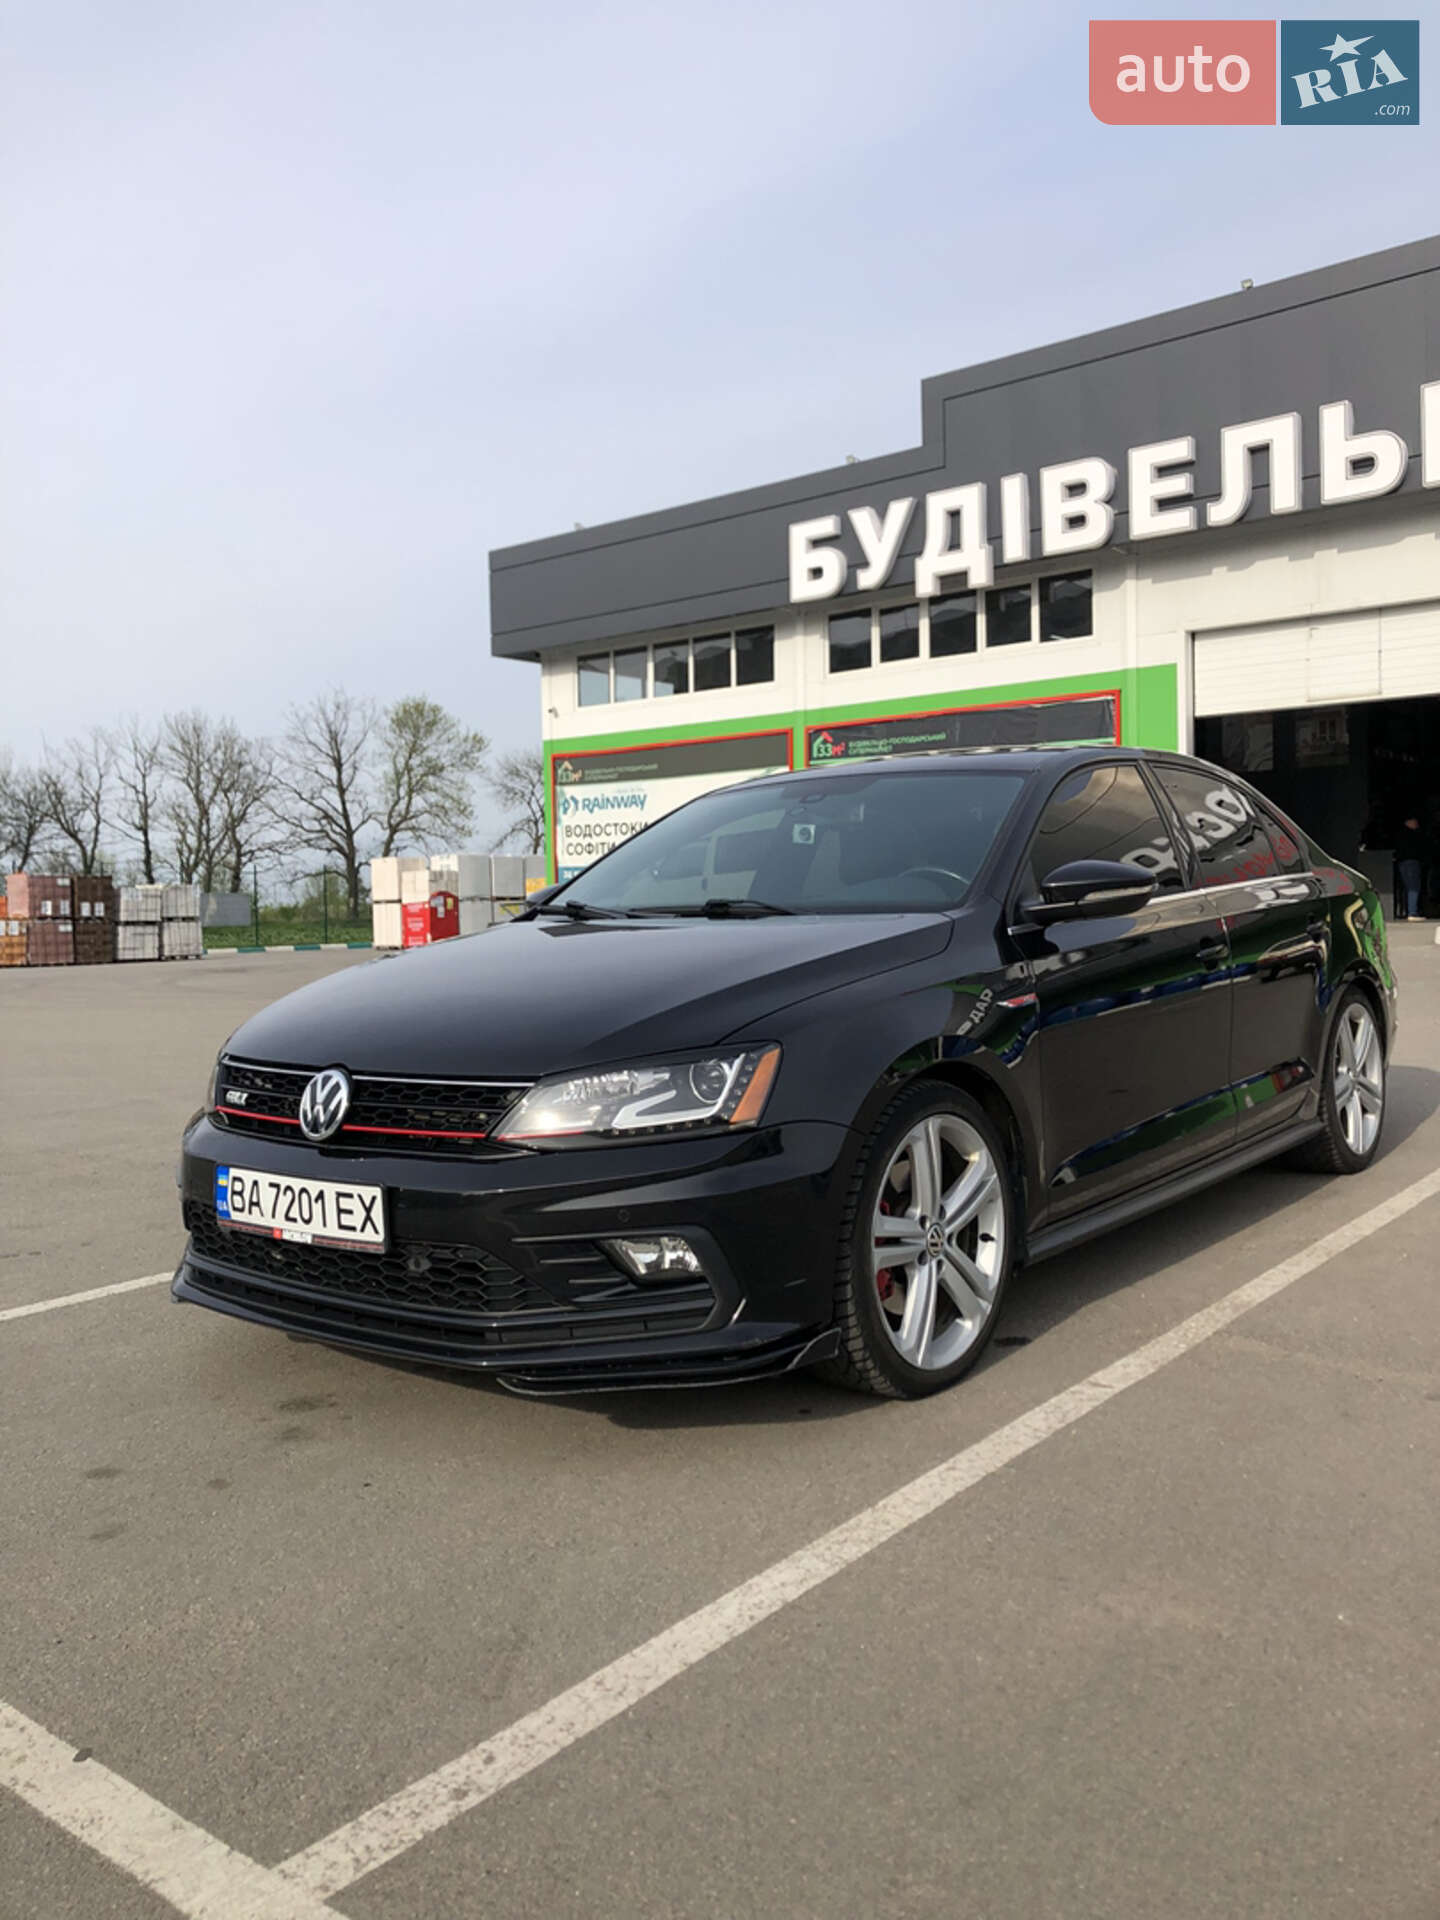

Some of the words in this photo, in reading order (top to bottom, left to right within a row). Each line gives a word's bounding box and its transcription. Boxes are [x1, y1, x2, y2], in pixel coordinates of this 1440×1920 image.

[788, 380, 1440, 603] БУДІВЕЛЬ
[231, 1176, 264, 1217] BA
[268, 1182, 327, 1228] 7201
[335, 1191, 379, 1235] EX
